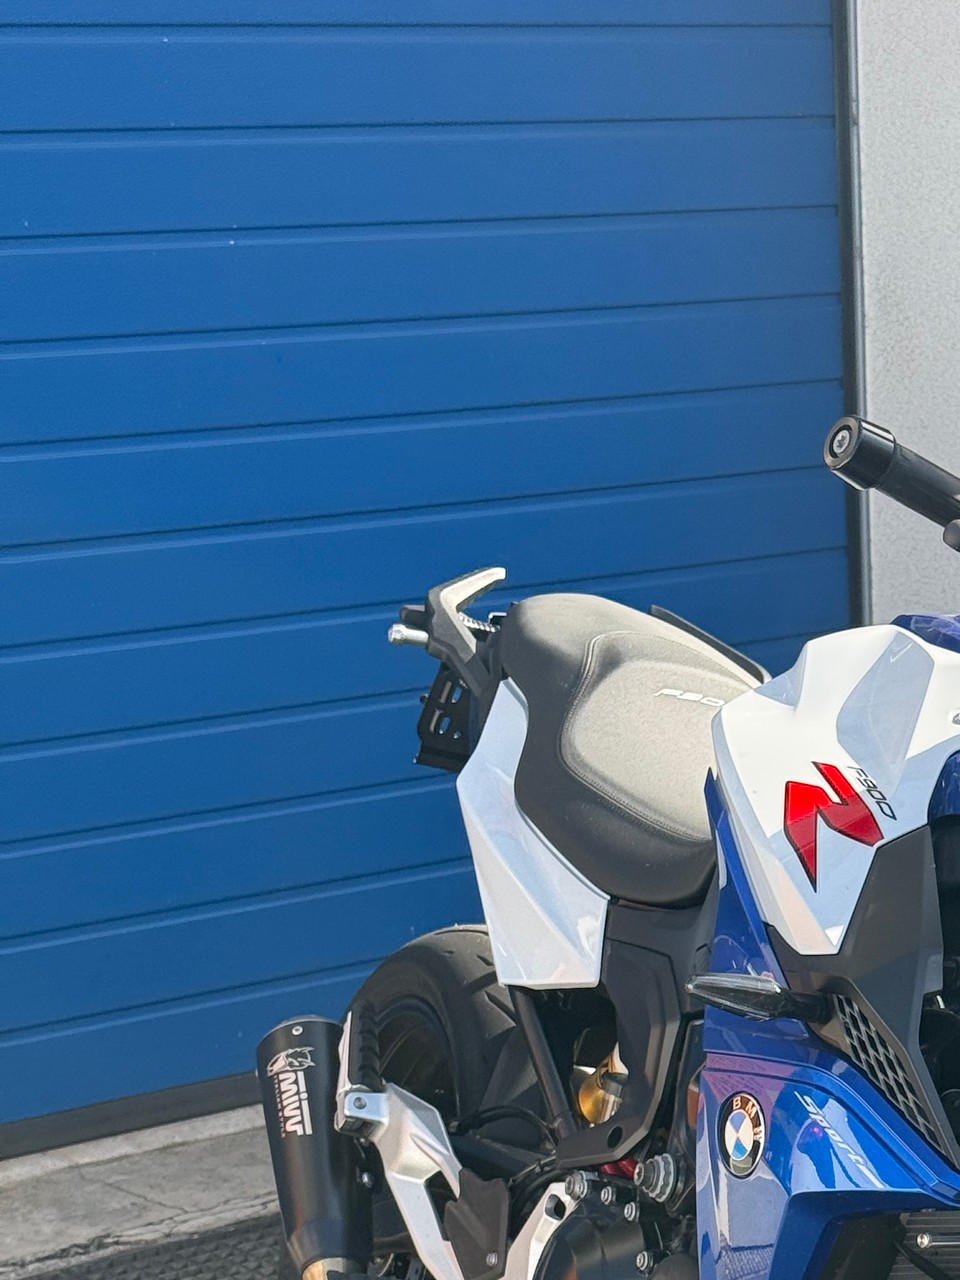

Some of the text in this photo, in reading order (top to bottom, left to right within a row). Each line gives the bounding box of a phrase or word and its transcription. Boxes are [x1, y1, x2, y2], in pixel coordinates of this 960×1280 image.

[846, 765, 898, 821] F900
[732, 1096, 763, 1141] BMW
[794, 1091, 876, 1180] Sport
